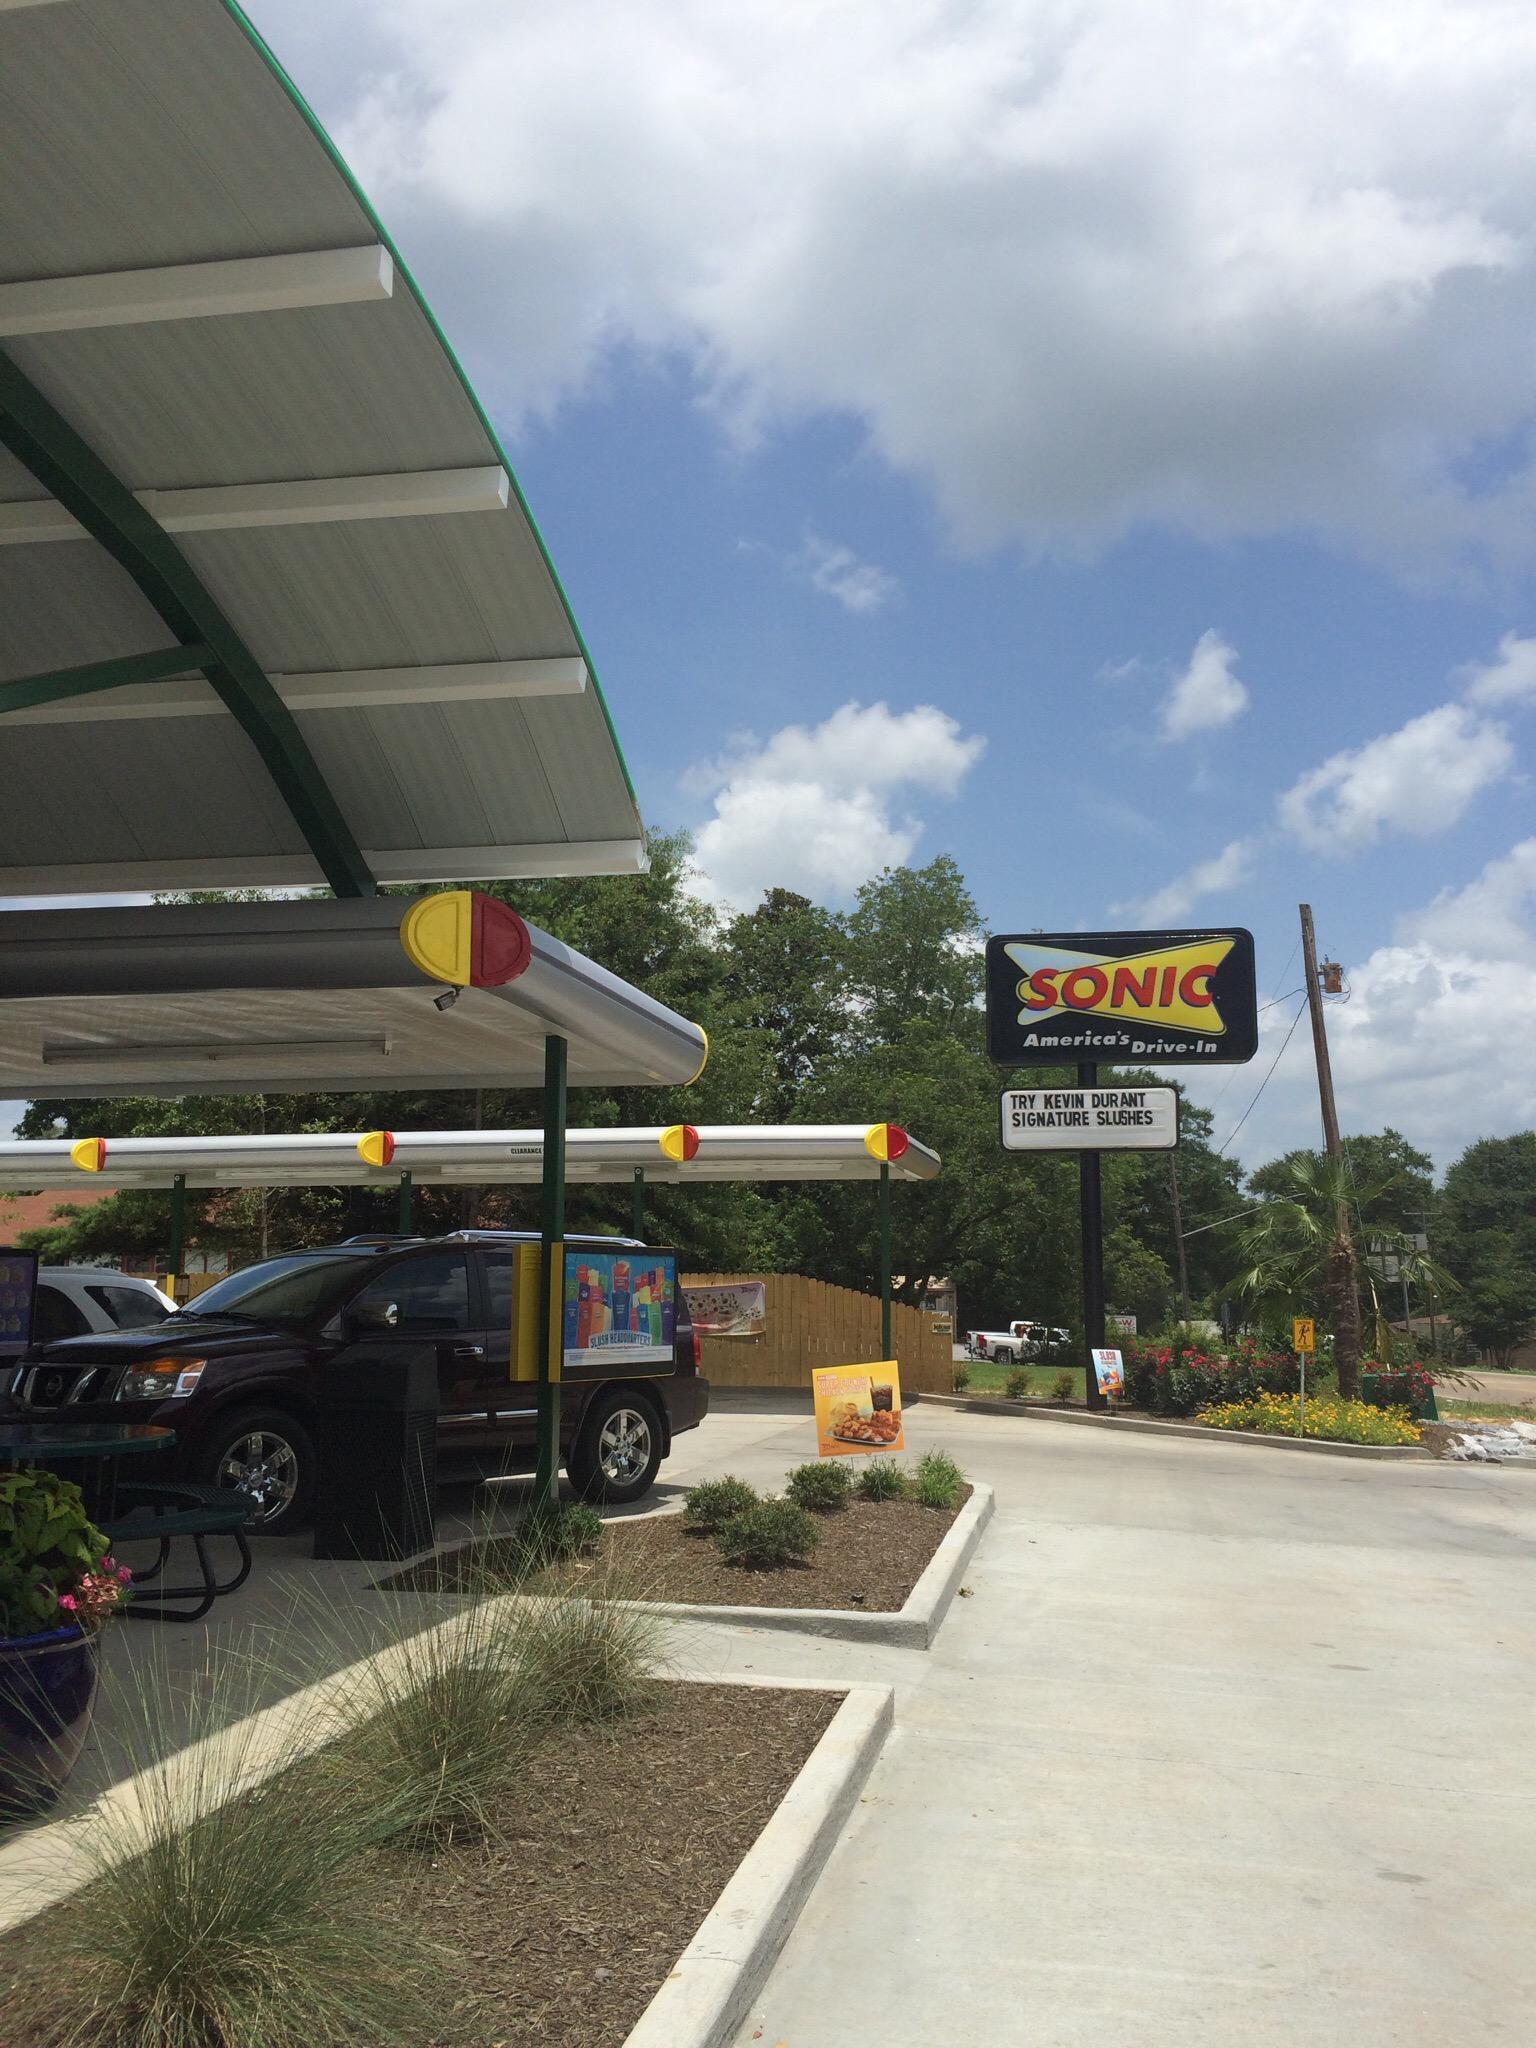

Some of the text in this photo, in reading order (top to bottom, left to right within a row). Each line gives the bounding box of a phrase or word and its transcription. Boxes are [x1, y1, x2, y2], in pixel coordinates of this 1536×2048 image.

[1024, 964, 1218, 1011] SONIC
[1023, 1030, 1130, 1047] America's
[1010, 1092, 1146, 1110] TRY KEVIN DURANT
[1012, 1110, 1153, 1128] SIGNATURE SLUSHES
[510, 1147, 543, 1155] CLEARANCE
[590, 1334, 609, 1348] SLUSH
[609, 1331, 651, 1346] HEADQUARTERS
